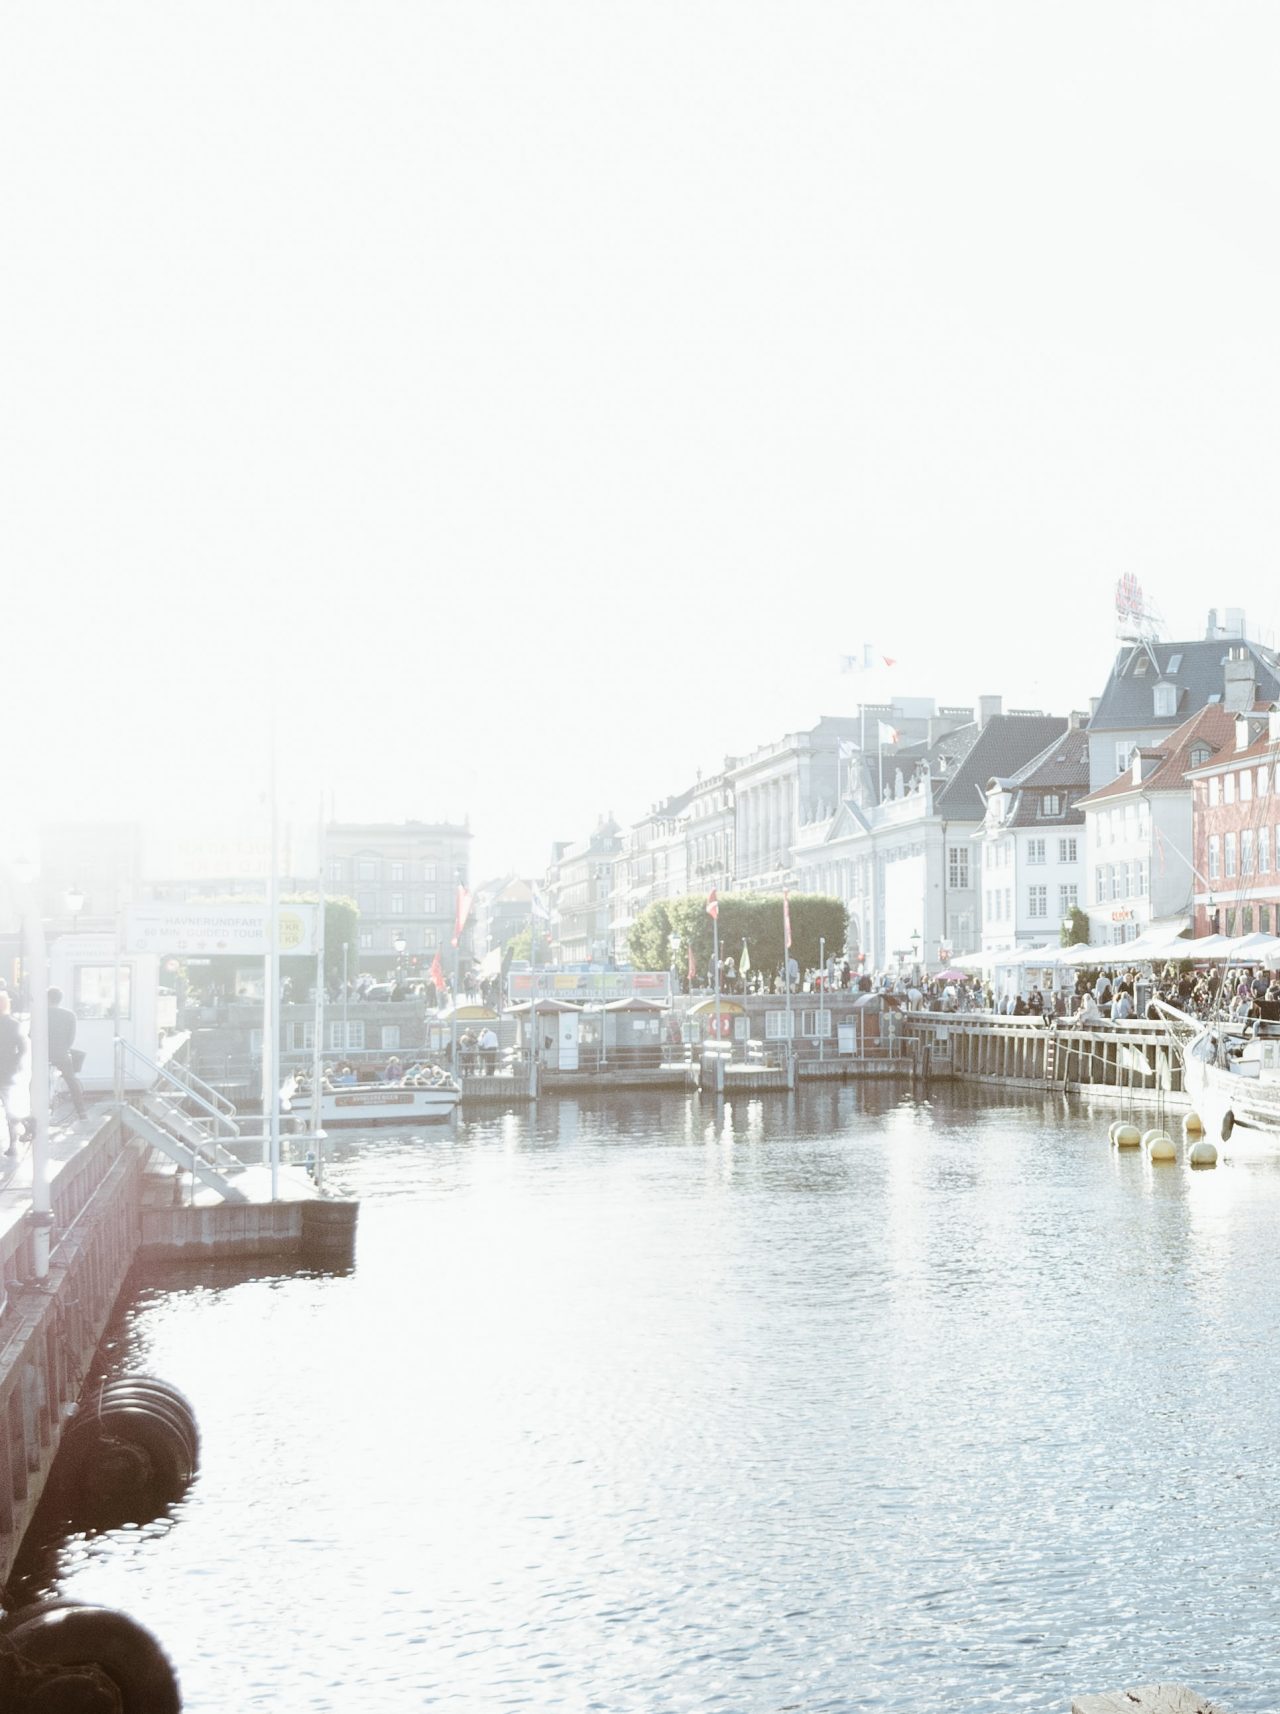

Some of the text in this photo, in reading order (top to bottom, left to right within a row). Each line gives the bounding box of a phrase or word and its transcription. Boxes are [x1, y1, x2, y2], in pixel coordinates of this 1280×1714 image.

[165, 917, 263, 927] HAVNERUNDFART
[186, 928, 230, 938] GUIDED
[233, 928, 264, 938] TOUR
[538, 989, 556, 997] BUY
[560, 989, 580, 997] YOUR
